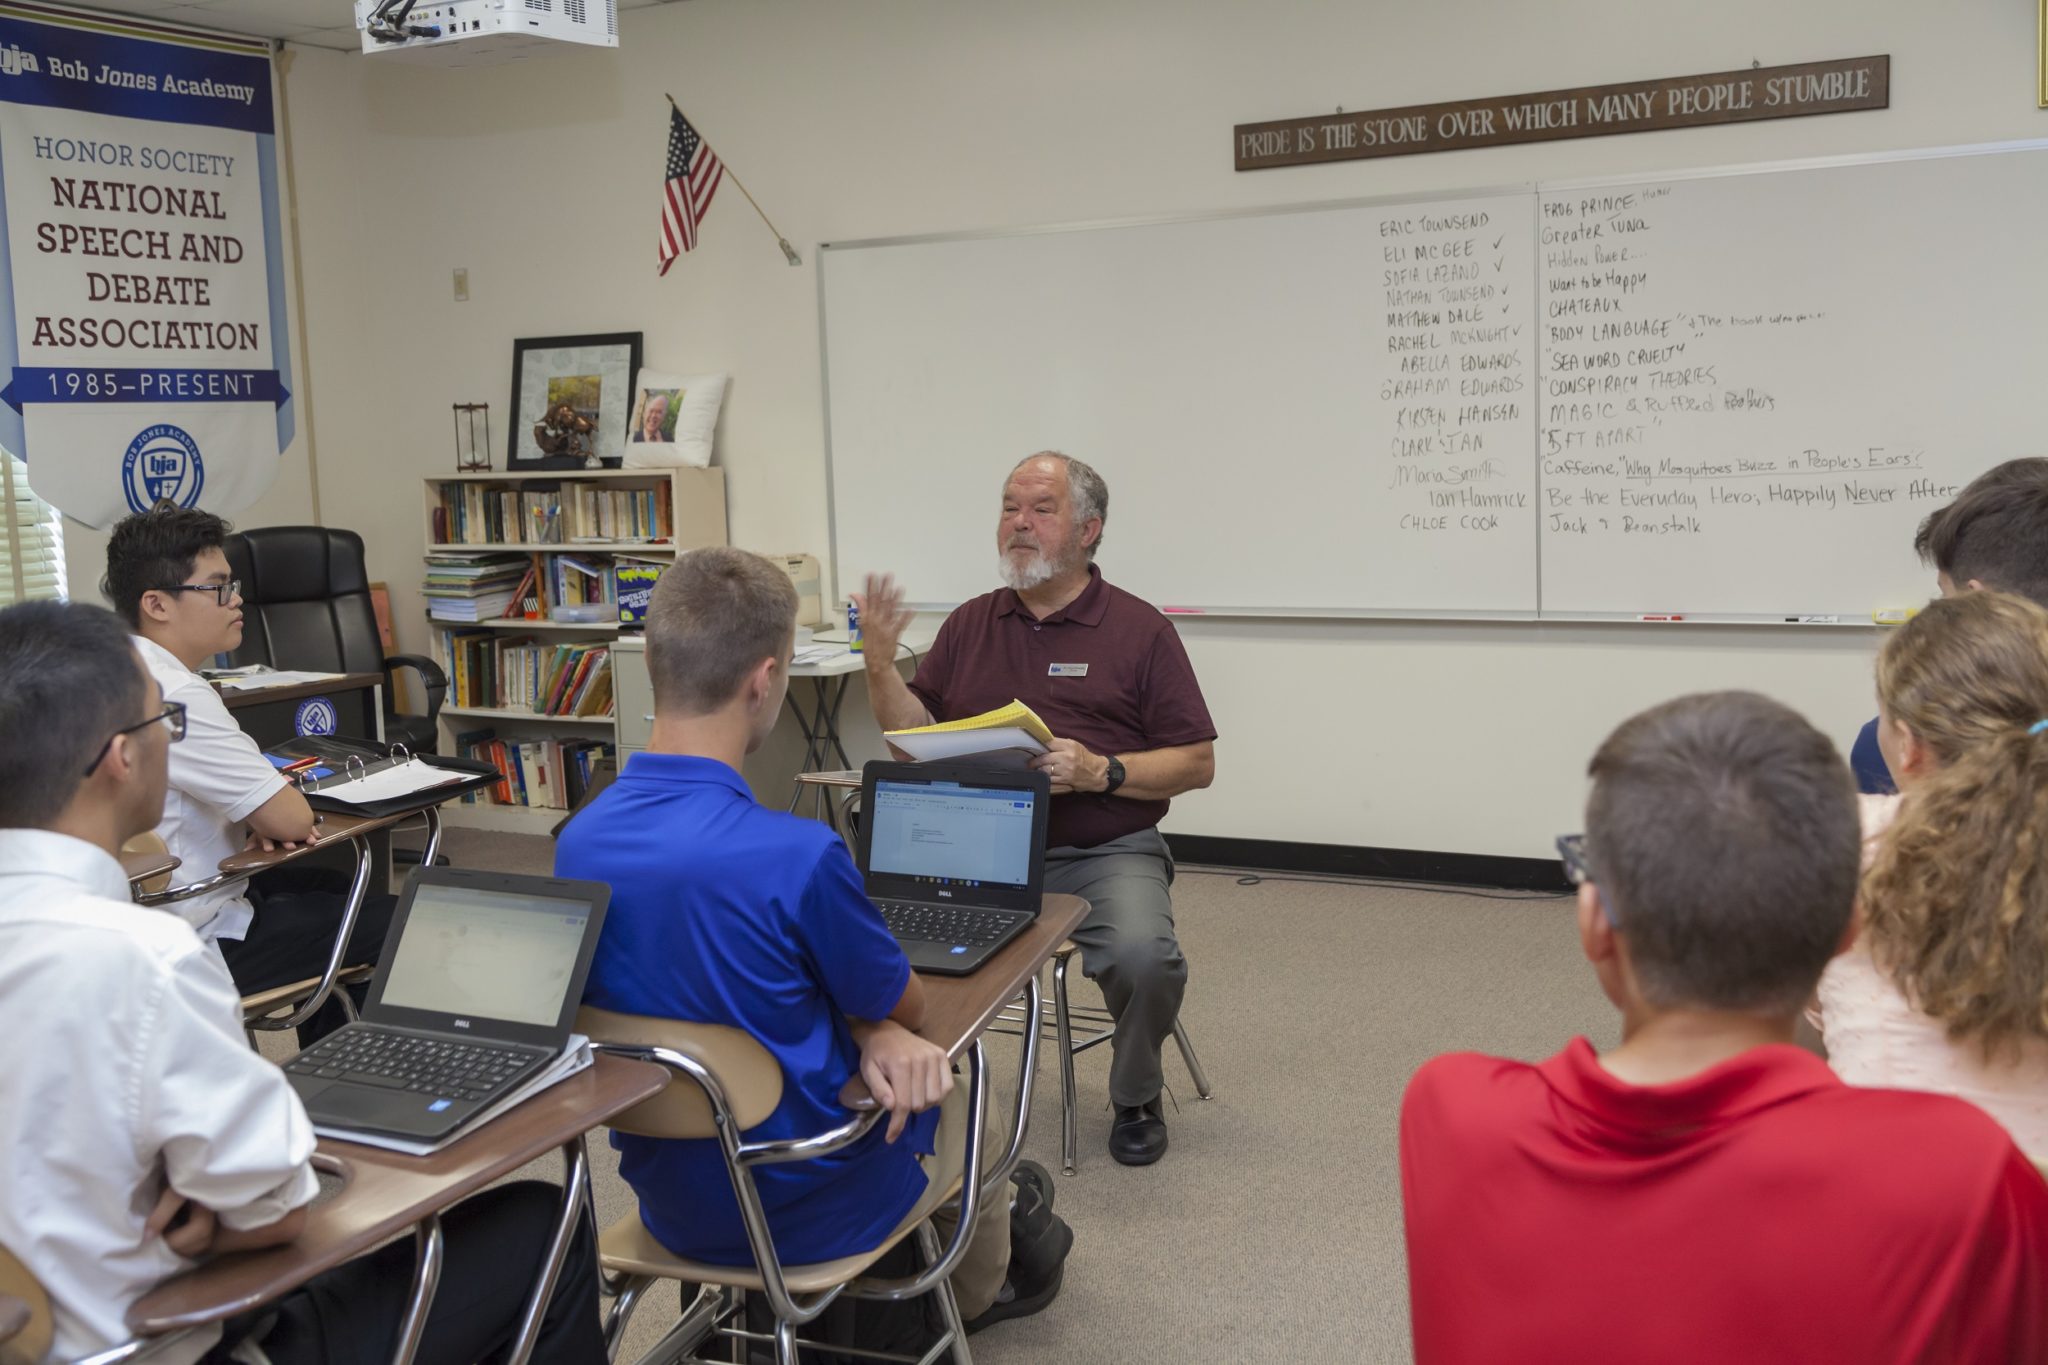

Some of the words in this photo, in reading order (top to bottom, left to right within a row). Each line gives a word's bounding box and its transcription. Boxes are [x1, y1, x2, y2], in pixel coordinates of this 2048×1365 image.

[47, 56, 89, 82] Bob
[95, 65, 157, 91] Jones
[162, 74, 255, 105] Academy
[1241, 129, 1292, 159] PRIDE
[1298, 127, 1315, 153] IS
[1320, 123, 1358, 150] THE
[1362, 116, 1428, 146] STONE
[1438, 108, 1496, 139] OVER
[1502, 100, 1577, 131] WHICH
[1588, 91, 1658, 124] MANY
[1667, 80, 1753, 116] PEOPLE
[1764, 68, 1872, 106] STUMBLE
[33, 136, 134, 167] HONOR
[140, 147, 235, 177] SOCIETY
[50, 177, 227, 220] NATIONAL
[1544, 202, 1574, 218] FROG
[1380, 219, 1416, 238] ERIC
[1419, 212, 1489, 232] TOWNSEND
[36, 222, 169, 260] SPEECH
[179, 234, 244, 264] AND
[1384, 246, 1406, 263] ELI
[86, 272, 211, 306] DEBATE
[1383, 267, 1419, 287] SOFIA
[1549, 277, 1577, 294] Want
[1581, 275, 1591, 290] to
[1592, 272, 1602, 289] be
[1605, 267, 1647, 295] Happy
[1387, 289, 1431, 307] NATHAN
[1438, 284, 1495, 304] TOWNSEND
[1387, 311, 1440, 328] MATTHEW
[1448, 304, 1484, 324] DALE
[1549, 297, 1623, 319] CHATEAUX
[32, 317, 259, 350] ASSOCIATION
[1388, 333, 1440, 353] RACHEL
[1461, 349, 1522, 373] EDWARDS
[1583, 350, 1621, 371] WORD
[1461, 374, 1524, 397] EDWARDS
[1648, 365, 1717, 393] THEORIES
[1397, 406, 1446, 429] KIRSTEN
[1458, 403, 1519, 426] HANSEN
[1550, 403, 1617, 425] MAGIC
[125, 446, 138, 469] BOB
[138, 428, 165, 446] JONES
[1392, 436, 1433, 458] CLARK
[1565, 431, 1586, 449] FT
[1658, 457, 1732, 484] Mosquitoes
[1737, 457, 1778, 473] Buzz
[1787, 454, 1799, 470] in
[1803, 449, 1862, 471] People's
[1429, 490, 1456, 508] Ian
[1460, 486, 1526, 508] Hamrick
[1547, 486, 1573, 507] Be
[1580, 486, 1610, 507] the
[1620, 487, 1698, 510] Everyday
[1768, 480, 1836, 511] Happily
[1844, 479, 1897, 501] Never
[1908, 476, 1960, 501] After
[1399, 513, 1448, 531] CHLOE
[1550, 512, 1588, 535] Jack
[1622, 513, 1701, 535] Beanstalk
[454, 1019, 469, 1028] DELL
